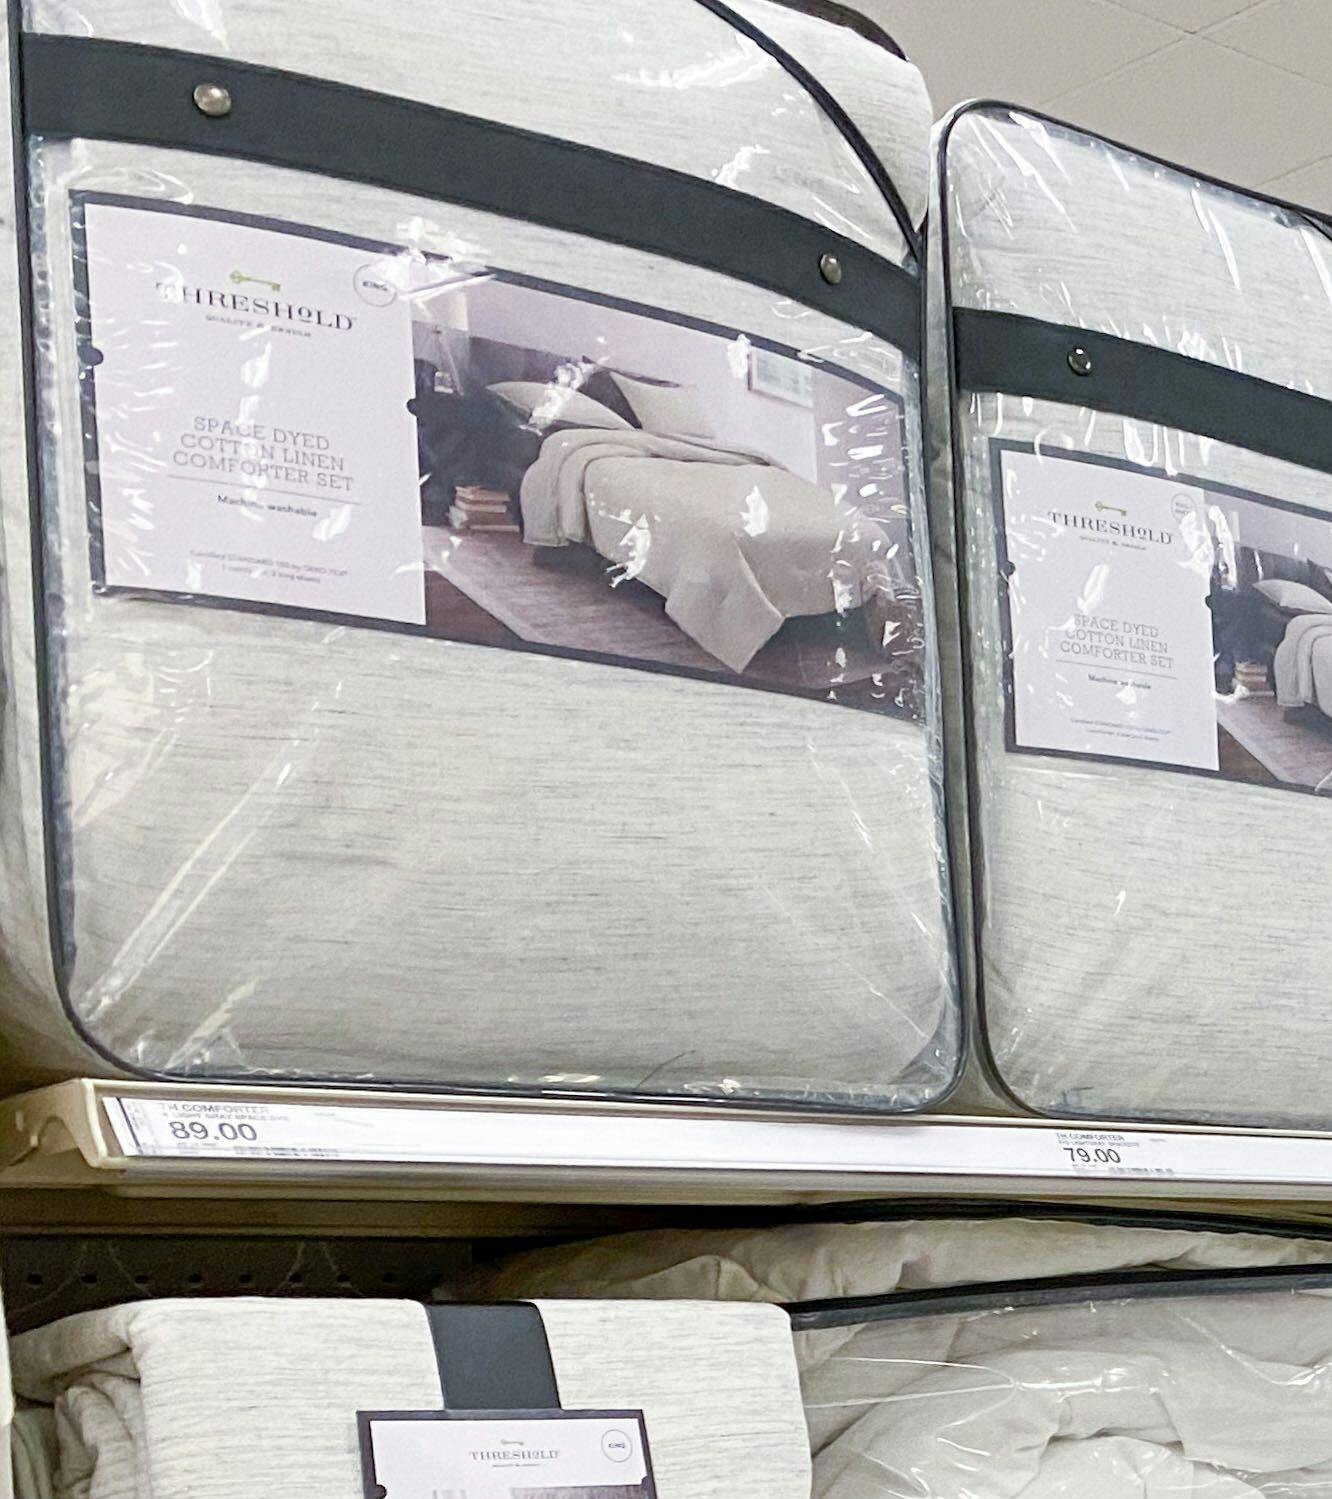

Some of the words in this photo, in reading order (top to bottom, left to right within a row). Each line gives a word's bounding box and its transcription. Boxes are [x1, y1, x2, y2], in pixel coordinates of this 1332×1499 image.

[180, 433, 275, 460] COTTON
[283, 447, 344, 471] LINEN
[273, 428, 330, 451] DYED
[173, 451, 309, 485] COMFORTER
[316, 472, 354, 491] SET
[1074, 613, 1119, 632] SPACE
[1123, 621, 1160, 638] DYED
[1065, 627, 1124, 647] COTTON
[1128, 637, 1168, 654] LINEN
[1060, 641, 1148, 666] COMFORTER
[1150, 653, 1175, 669] SET
[181, 1104, 270, 1115] COMFORTER
[168, 1121, 258, 1142] 89.00
[1063, 1147, 1121, 1164] 79.00
